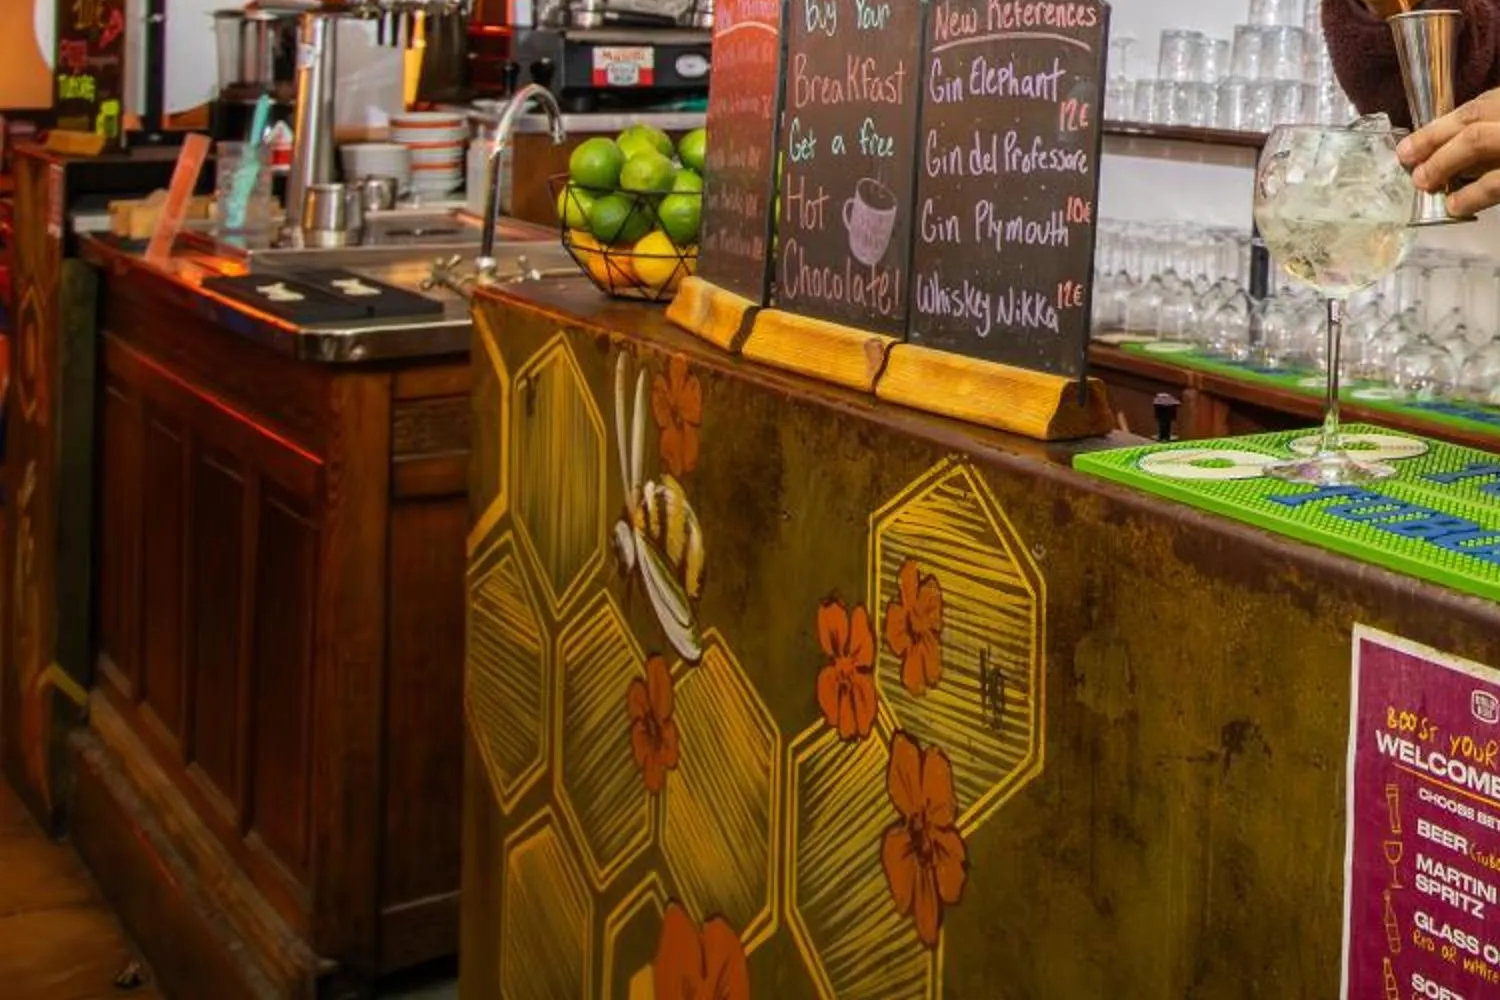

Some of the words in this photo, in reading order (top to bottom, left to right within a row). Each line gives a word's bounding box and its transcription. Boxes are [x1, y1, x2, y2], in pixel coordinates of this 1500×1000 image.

[934, 0, 977, 41] New
[929, 56, 964, 104] Gin
[1058, 100, 1089, 132] 12€
[789, 117, 816, 162] Get
[831, 133, 846, 156] a
[925, 128, 963, 177] Gin
[969, 129, 998, 176] del
[786, 172, 831, 231] Hot
[921, 198, 961, 244] Gin
[975, 200, 1069, 251] Plymouth
[1057, 279, 1083, 310] 12€
[1449, 732, 1500, 769] YOUR
[1417, 787, 1476, 823] CHOOSE
[1416, 817, 1468, 855] BEER
[1415, 873, 1485, 921] SPRITZ
[1416, 852, 1498, 906] MARTINI
[1413, 910, 1481, 957] GLASS
